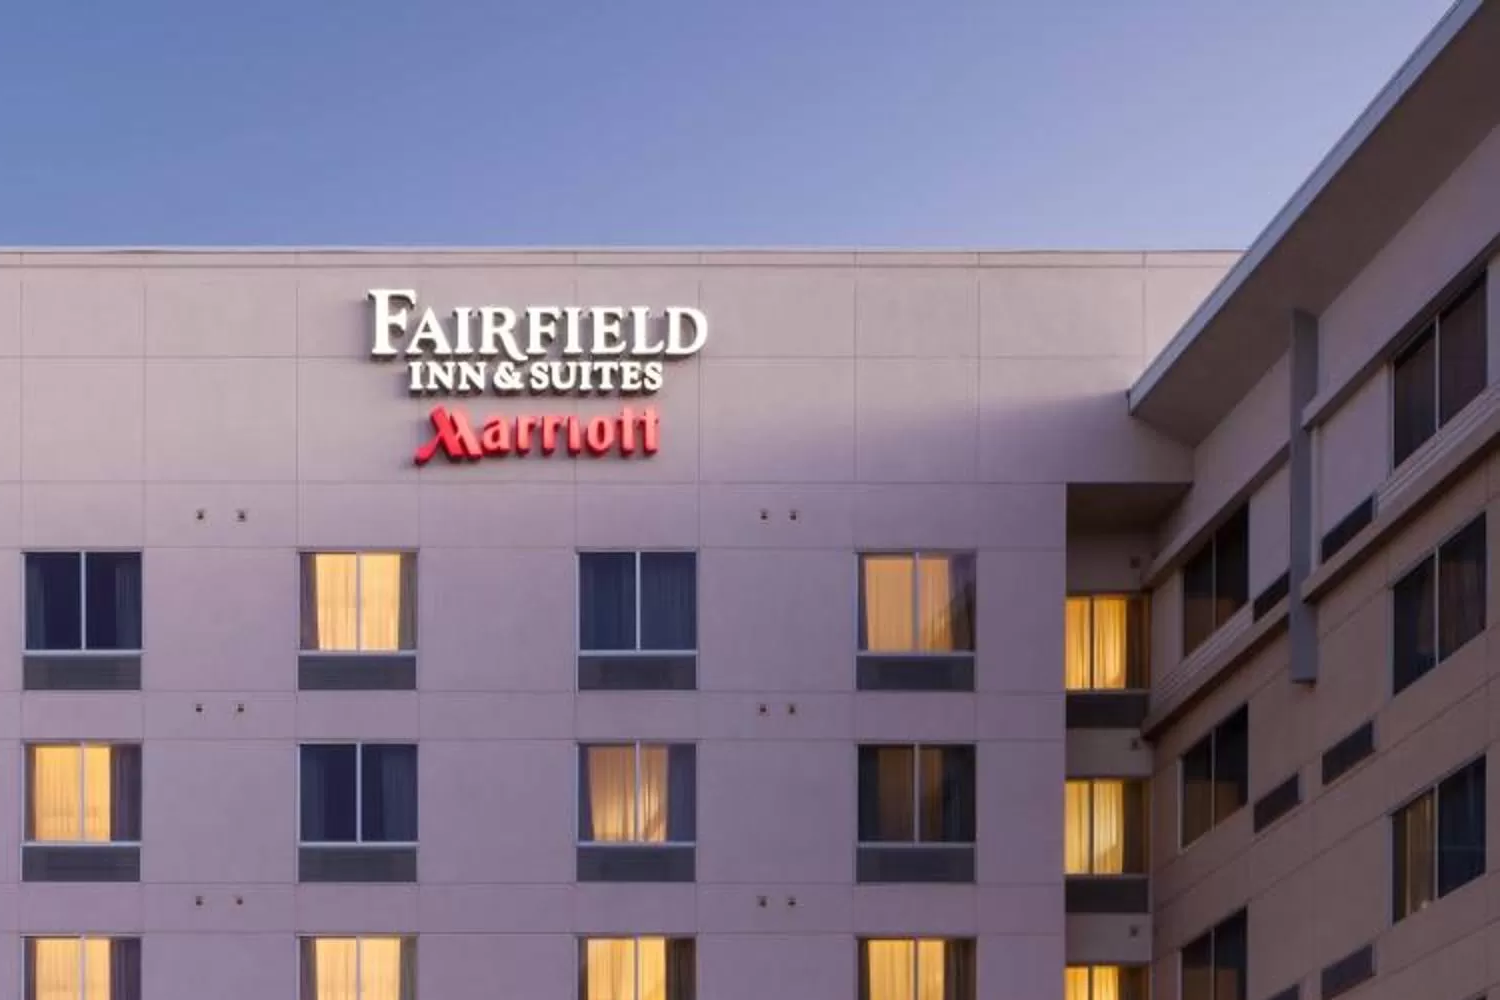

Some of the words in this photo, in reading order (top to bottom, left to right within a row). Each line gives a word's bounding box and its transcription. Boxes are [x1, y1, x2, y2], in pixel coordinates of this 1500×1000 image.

[367, 288, 709, 361] FAIRFIELD
[409, 361, 486, 391] INN
[493, 361, 523, 391] &
[530, 360, 664, 391] SUITES
[414, 405, 660, 464] Marriott
